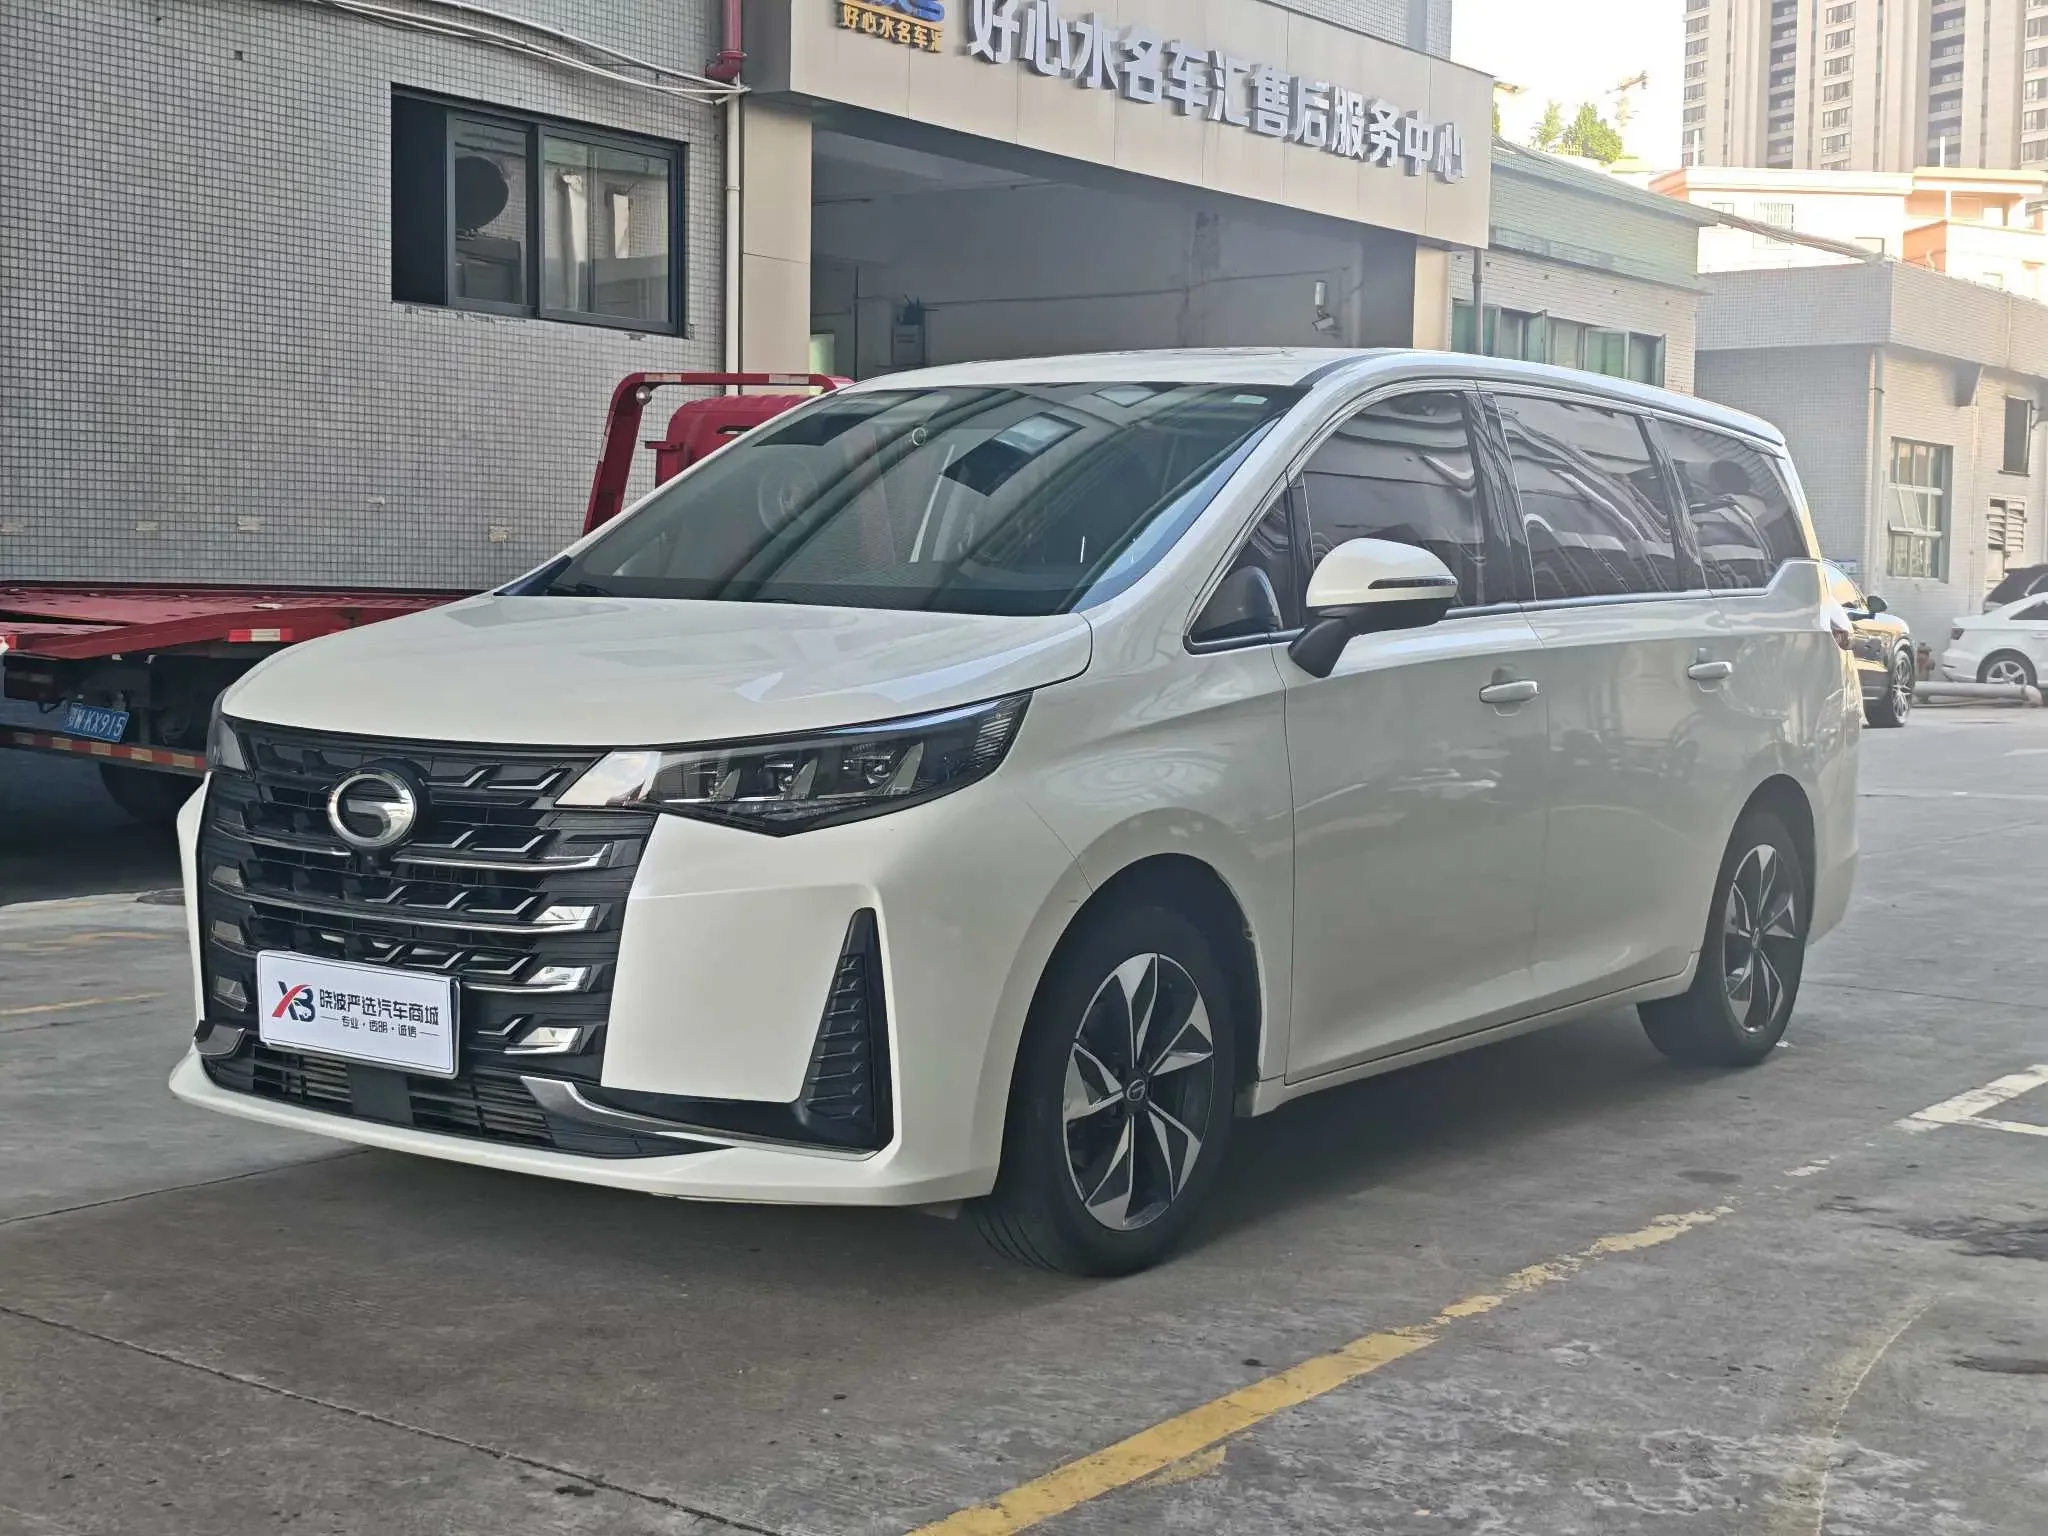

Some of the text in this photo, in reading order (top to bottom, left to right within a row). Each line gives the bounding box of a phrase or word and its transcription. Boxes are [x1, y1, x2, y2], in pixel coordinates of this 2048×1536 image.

[967, 0, 1467, 183] 好心水名车汇售后服务中心
[319, 988, 439, 1026] 晓波严选汽车商城
